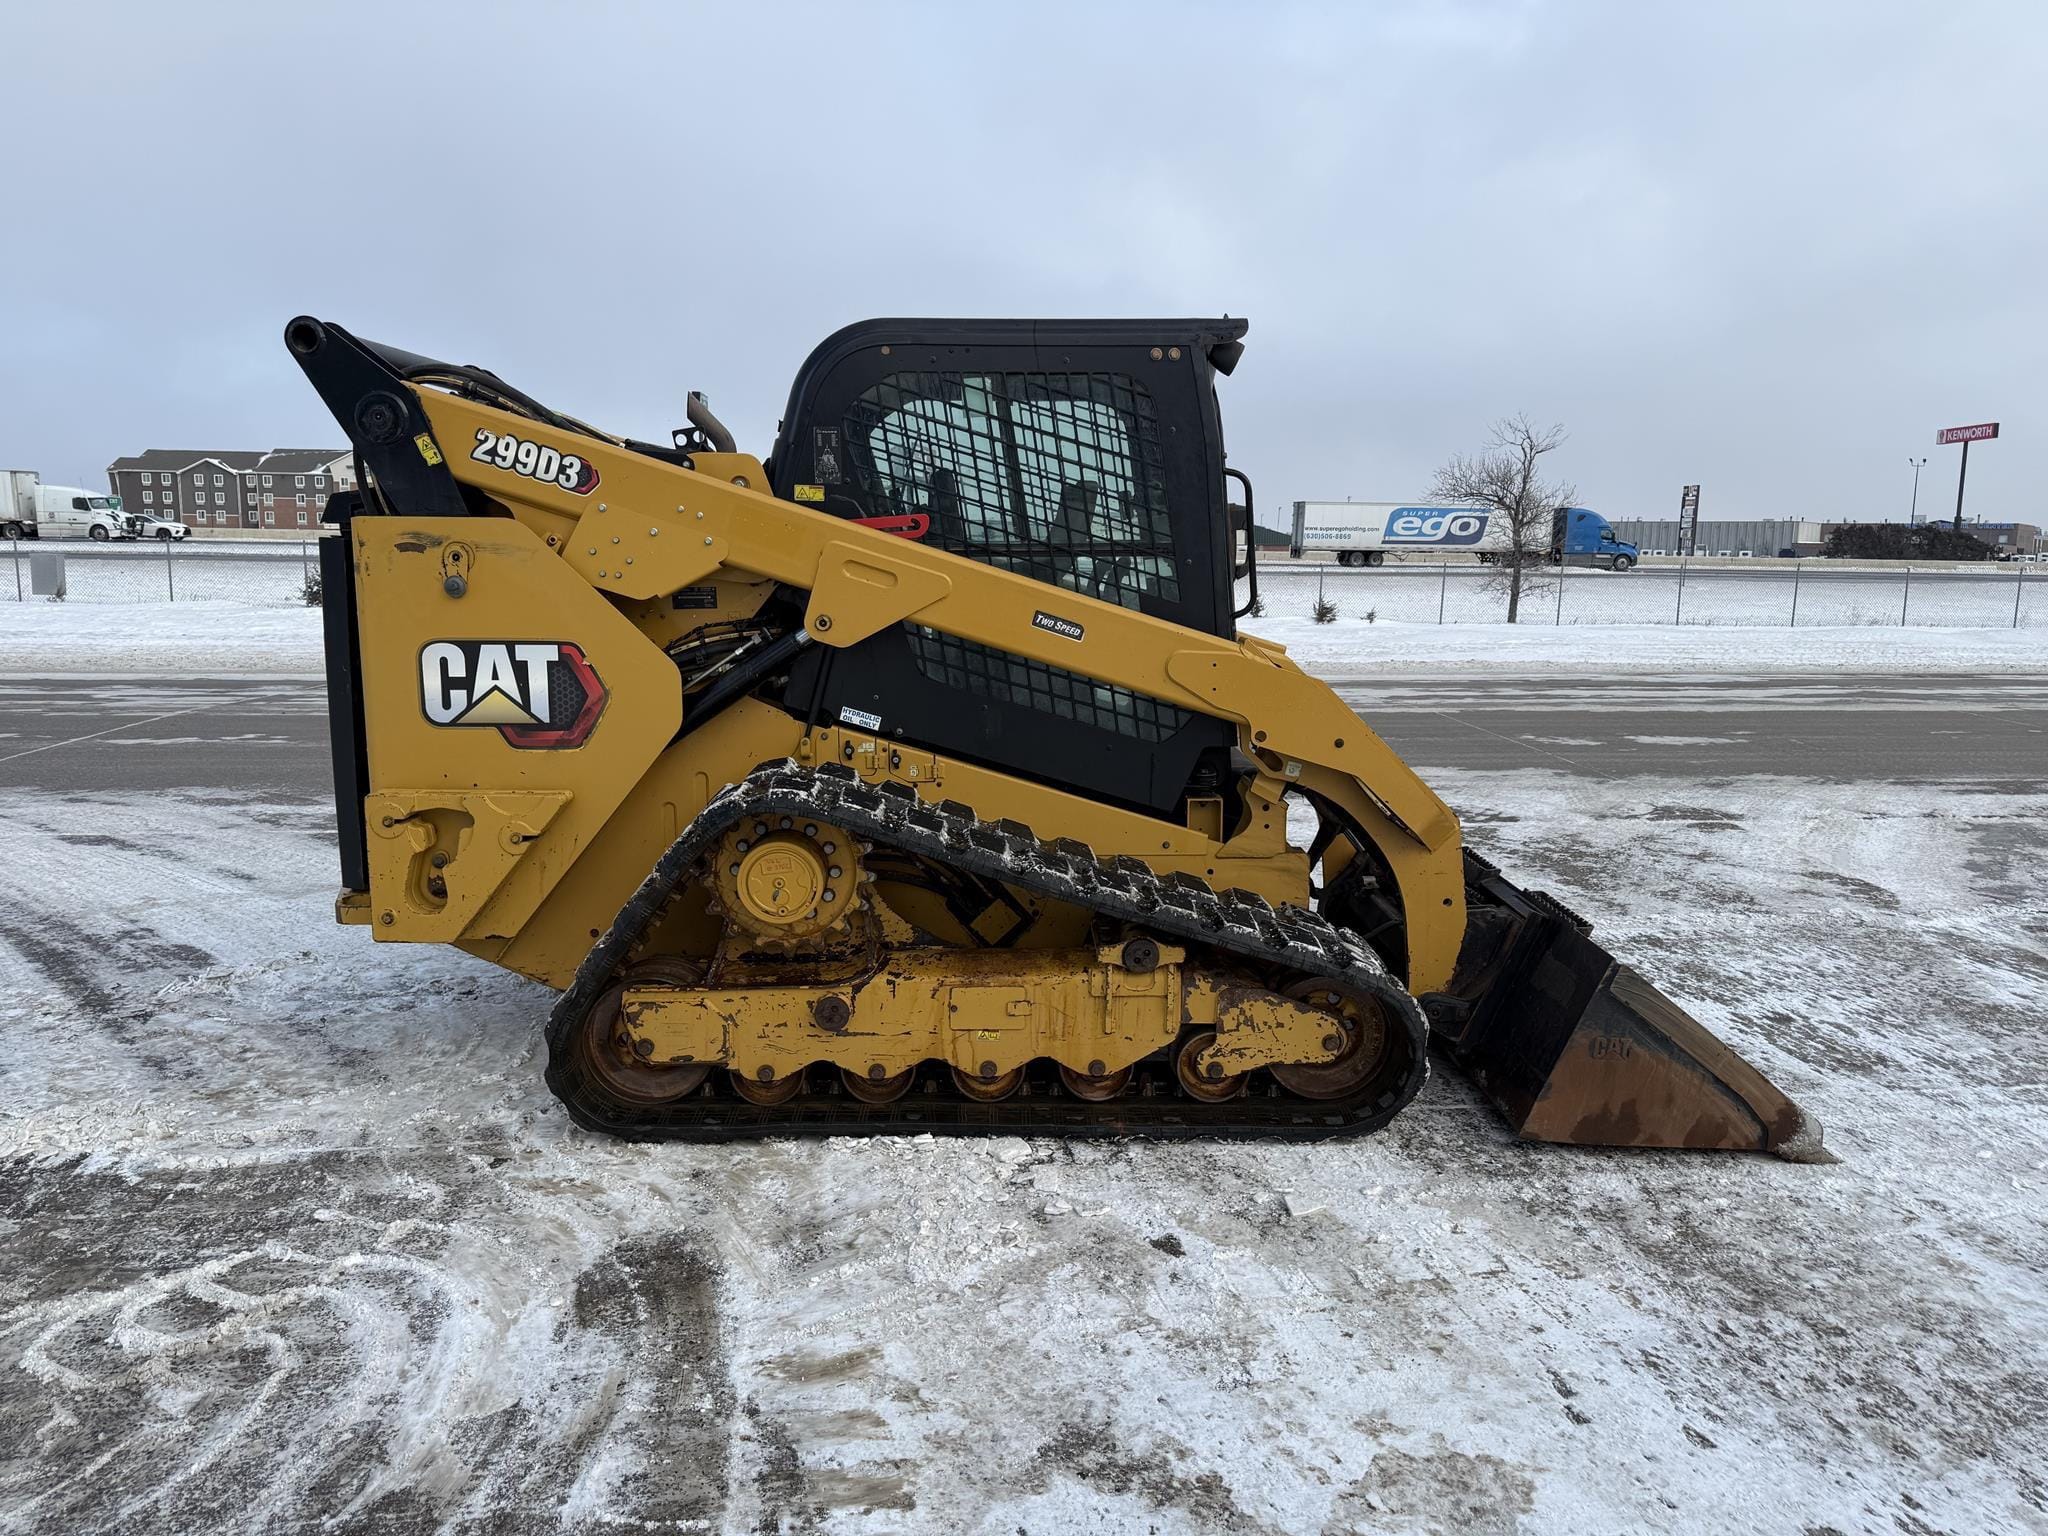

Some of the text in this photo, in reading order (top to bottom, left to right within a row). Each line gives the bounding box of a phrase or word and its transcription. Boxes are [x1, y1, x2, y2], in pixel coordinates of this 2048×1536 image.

[1947, 426, 1992, 440] KENWORTH
[472, 429, 581, 488] 299D3
[1392, 516, 1481, 540] ego
[421, 642, 559, 724] CAT
[842, 707, 880, 723] HYDRAULIC
[858, 719, 877, 729] ONLY
[1592, 1036, 1632, 1059] CAT
